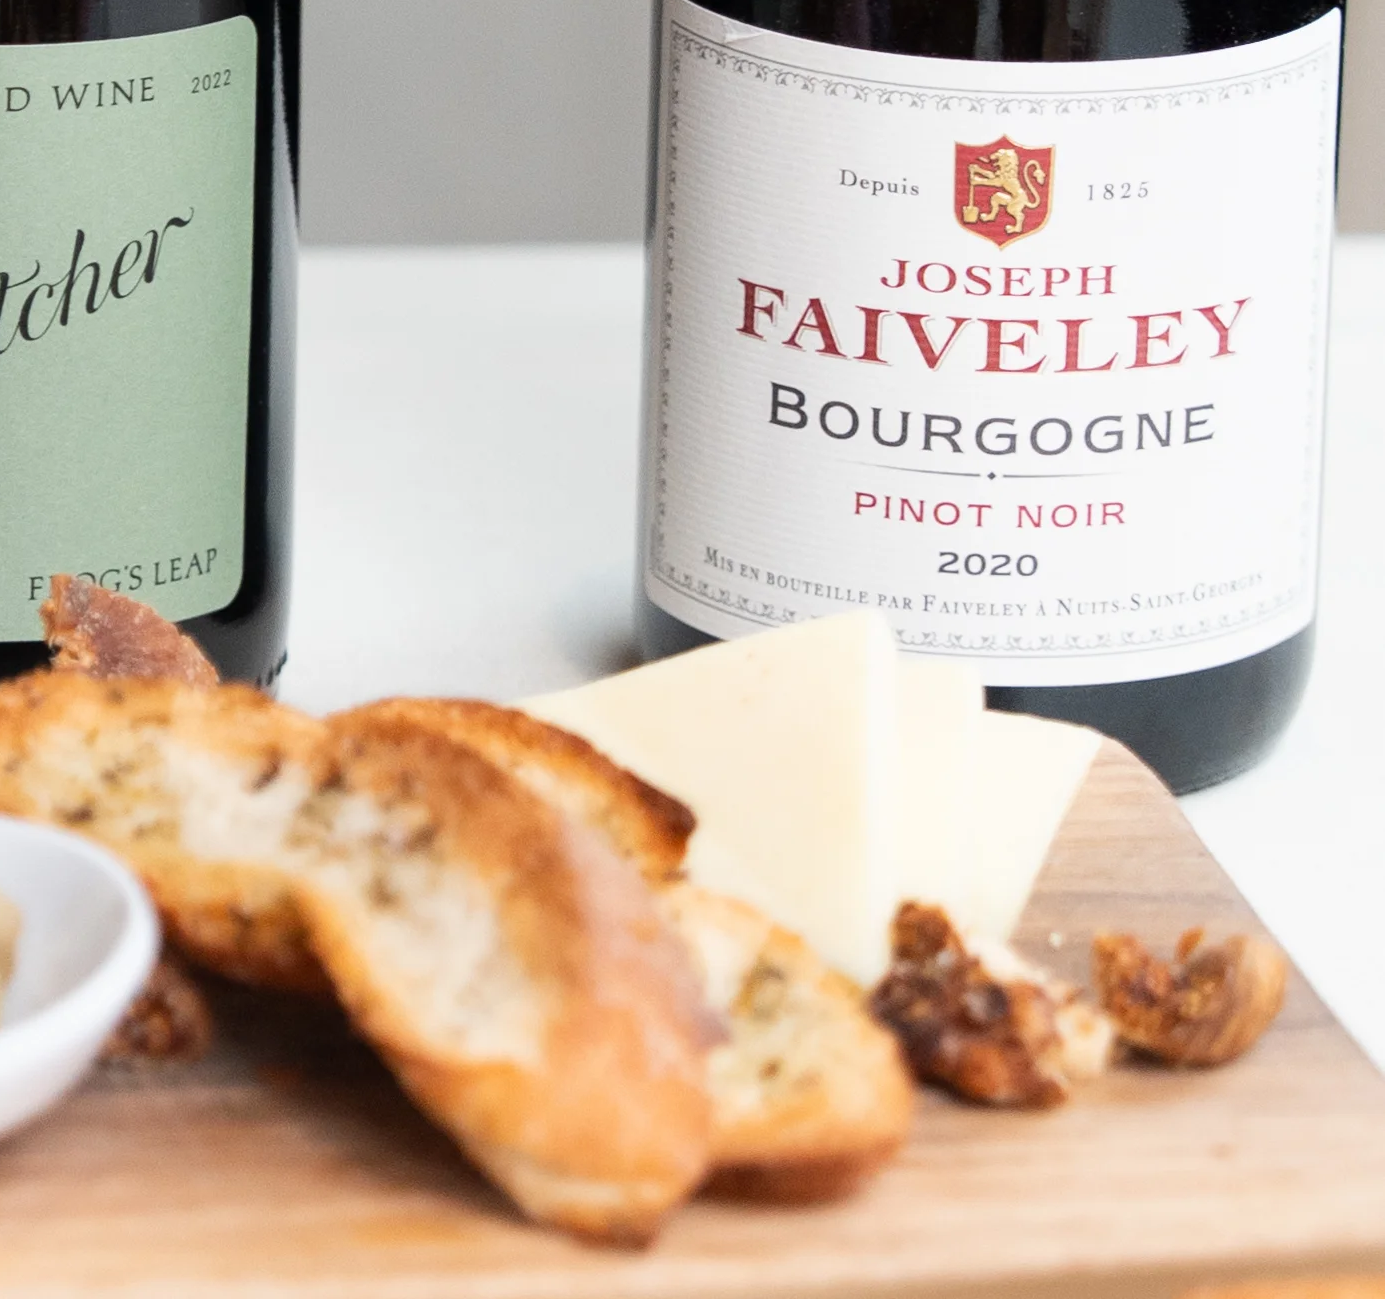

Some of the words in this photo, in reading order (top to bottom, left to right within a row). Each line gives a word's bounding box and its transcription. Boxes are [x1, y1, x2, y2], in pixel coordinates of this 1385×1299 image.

[52, 76, 156, 111] WINE
[190, 68, 233, 95] 2022
[838, 168, 920, 197] Depuis
[1087, 181, 1151, 202] 1825
[880, 258, 1118, 297] JOSEPH
[735, 277, 1253, 376] FAIVELEY
[768, 381, 1216, 456] BOURGOGNE
[853, 492, 993, 528] PINOT
[1016, 502, 1126, 529] NOIR
[153, 548, 217, 586] LEAP
[704, 546, 734, 573] MIS
[740, 563, 760, 581] EN
[766, 571, 869, 604] BOUTEILLE
[877, 593, 913, 611] PAR
[922, 594, 1027, 617] FAIVELEY
[937, 551, 1039, 577] 2020
